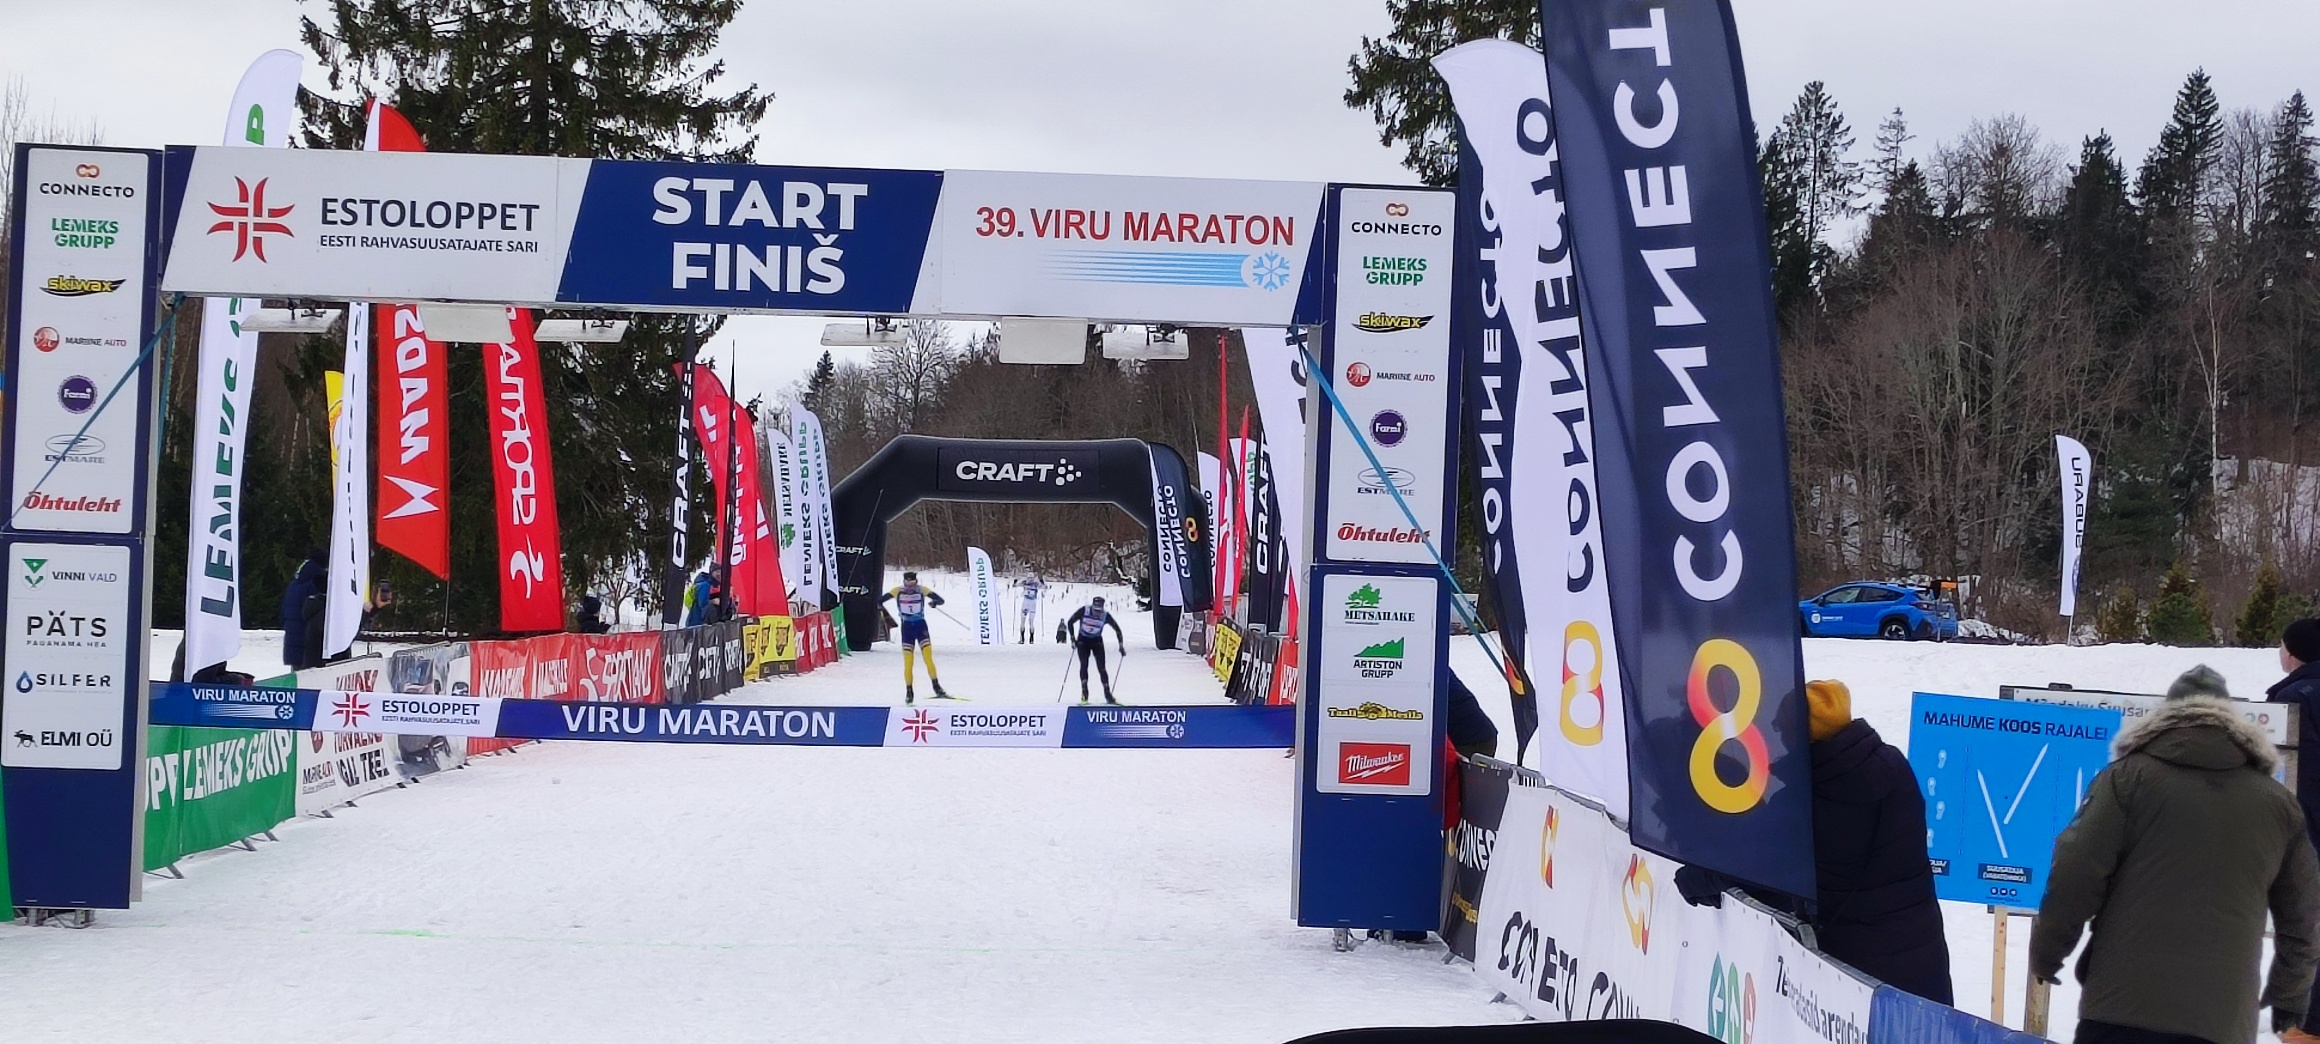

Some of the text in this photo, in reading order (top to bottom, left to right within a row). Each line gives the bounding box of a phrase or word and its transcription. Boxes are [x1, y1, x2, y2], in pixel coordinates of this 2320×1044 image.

[39, 181, 135, 198] CONNECTO
[651, 176, 869, 231] START
[320, 198, 540, 232] ESTOLOPPET
[51, 217, 119, 234] LEMEKS
[975, 206, 1295, 246] 39. VIRU MARATON
[1351, 221, 1442, 236] CONNECTO
[54, 233, 116, 250] GRUPP
[320, 235, 539, 254] EESTI RAHVASUUSATAJATE SARI
[672, 233, 846, 295] FINIŠ
[1362, 256, 1428, 271] LEMEKS
[47, 275, 113, 293] skiwax
[1365, 271, 1424, 286] GRUPP
[1360, 312, 1422, 329] skiwax
[104, 339, 128, 347] AUTO
[1413, 374, 1436, 382] AUTO
[956, 461, 1054, 482] CRAFT
[672, 405, 692, 568] CRAFT
[23, 491, 122, 513] Õhtuleht
[51, 570, 118, 583] VINNI VALD
[26, 609, 108, 638] PÄTS
[1344, 610, 1416, 622] METSAHAKE
[1353, 660, 1403, 669] ARTISTON
[36, 673, 111, 688] SILFER
[1361, 669, 1394, 679] GRUPP
[192, 687, 296, 704] VIRU MARATON
[382, 700, 480, 717] ESTOLOPPET
[562, 705, 836, 738] VIRU MARATON
[950, 715, 1047, 728] ESTOLOPPET
[1087, 711, 1187, 724] VIRU MARATON
[1924, 710, 2108, 741] MAHUME KOOS RAJALE!
[41, 728, 113, 747] ELMI OÜ
[183, 737, 246, 801] LEMEKS
[1344, 750, 1405, 773] Milwaukee
